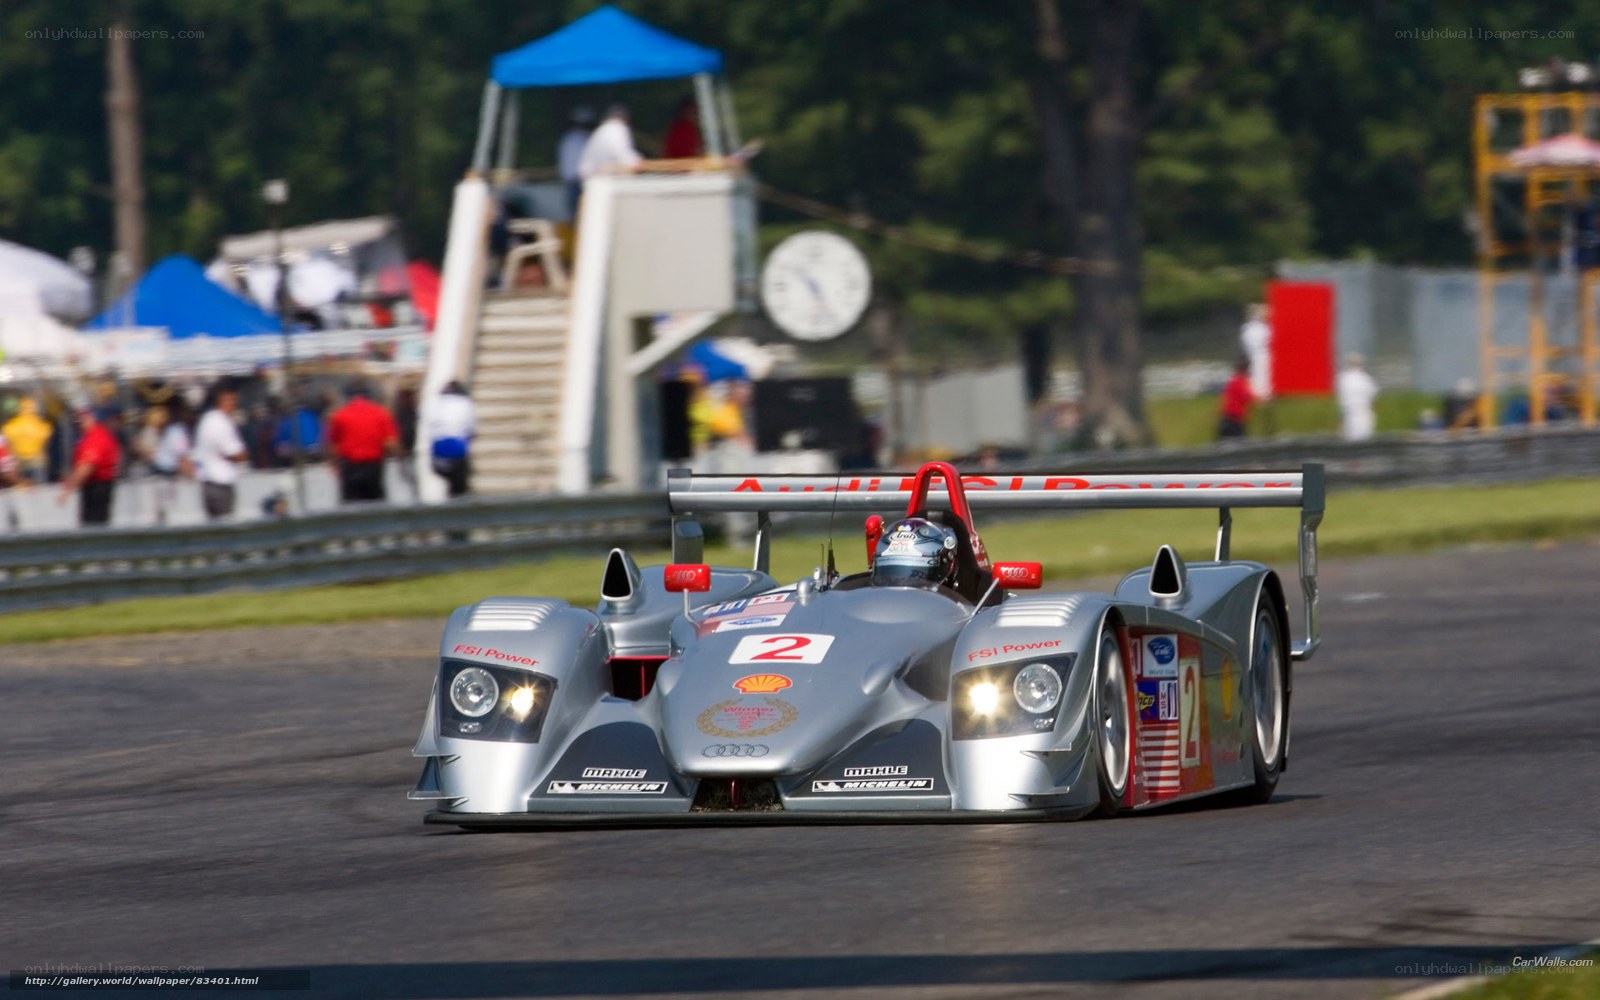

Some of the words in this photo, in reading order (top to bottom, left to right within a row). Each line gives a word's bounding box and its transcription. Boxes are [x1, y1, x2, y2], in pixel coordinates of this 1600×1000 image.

[731, 479, 881, 492] Adi
[750, 636, 812, 661] 2
[968, 648, 998, 663] FSI
[1002, 640, 1062, 654] Power
[453, 644, 483, 656] FSI
[485, 648, 540, 667] Power
[1184, 666, 1197, 759] 2
[584, 768, 647, 778] MAHLE
[845, 766, 907, 777] MAHLE
[577, 782, 660, 792] MICHELIN
[843, 780, 928, 789] MICHELIN
